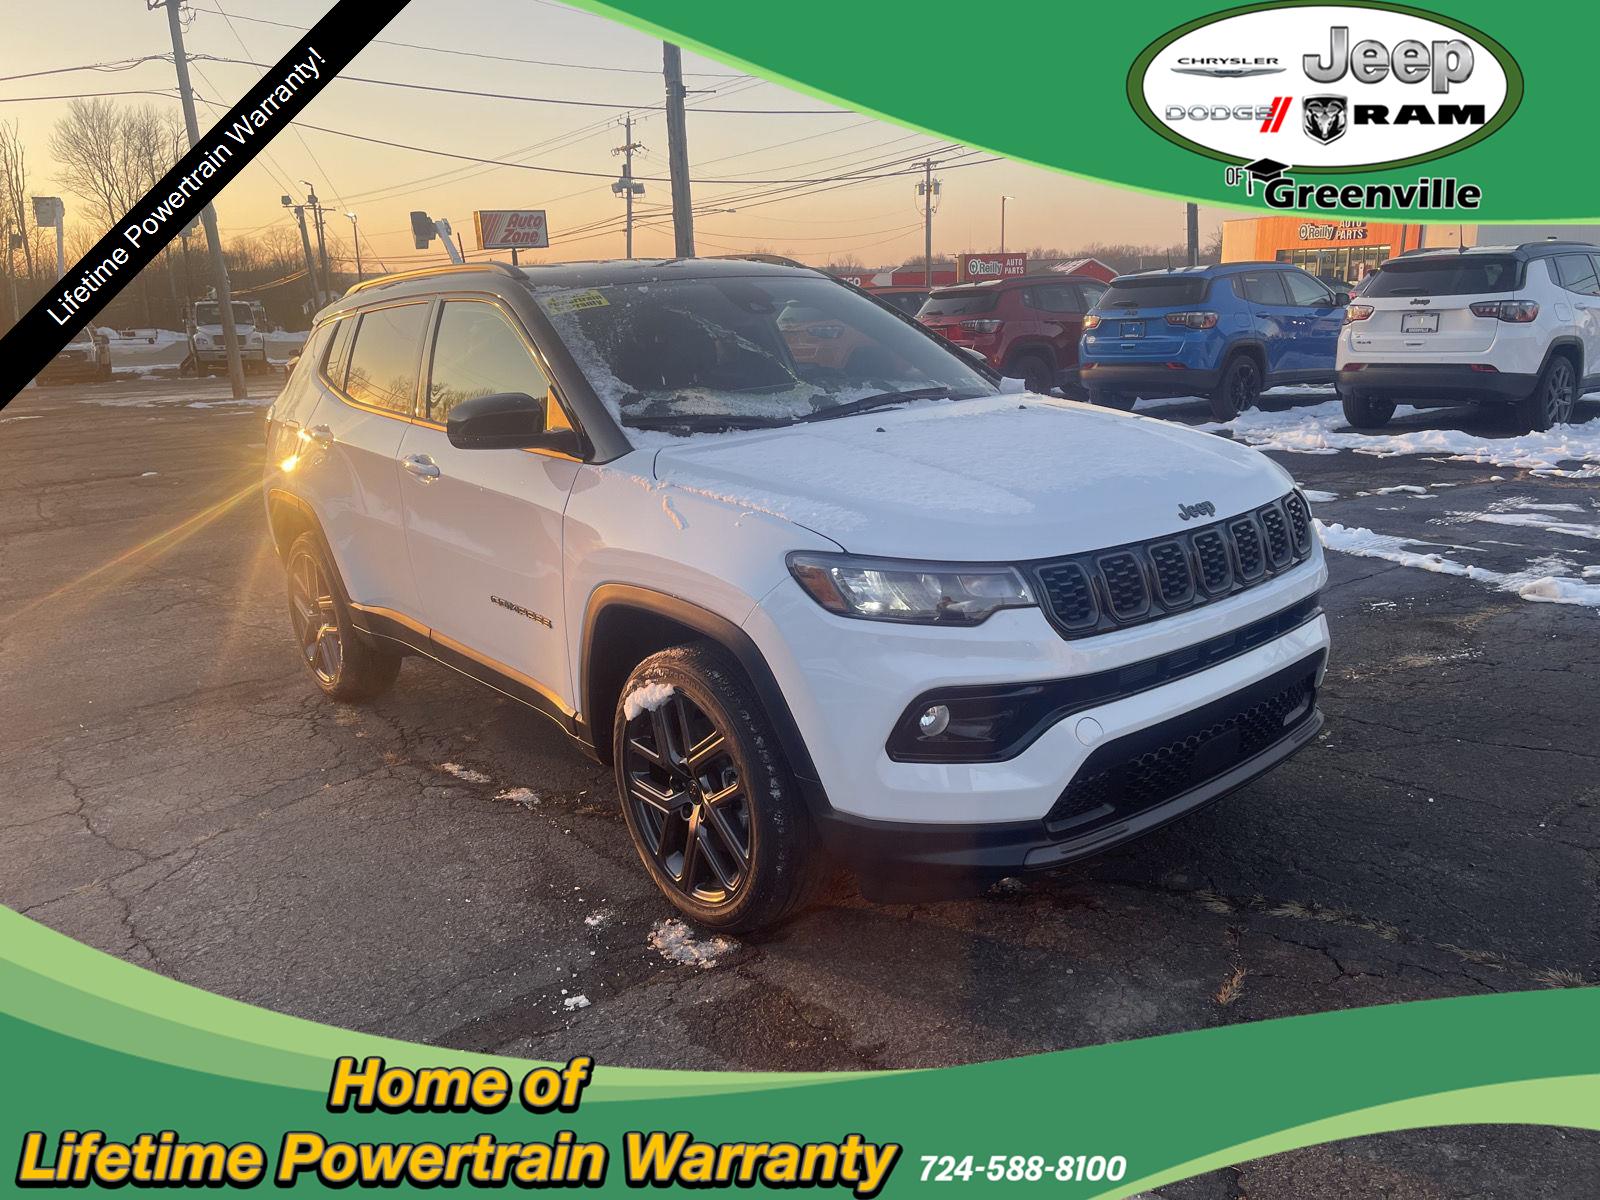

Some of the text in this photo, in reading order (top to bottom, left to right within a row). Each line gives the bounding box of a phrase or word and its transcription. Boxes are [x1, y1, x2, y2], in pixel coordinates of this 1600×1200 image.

[507, 213, 543, 228] Auto
[501, 228, 539, 243] Zone
[1299, 224, 1334, 240] O'Reilly
[1336, 229, 1364, 240] PARTS
[968, 258, 1003, 276] O'Reilly
[1006, 258, 1023, 267] AUTO
[1004, 266, 1024, 275] PARTS
[1178, 500, 1216, 521] Jeep
